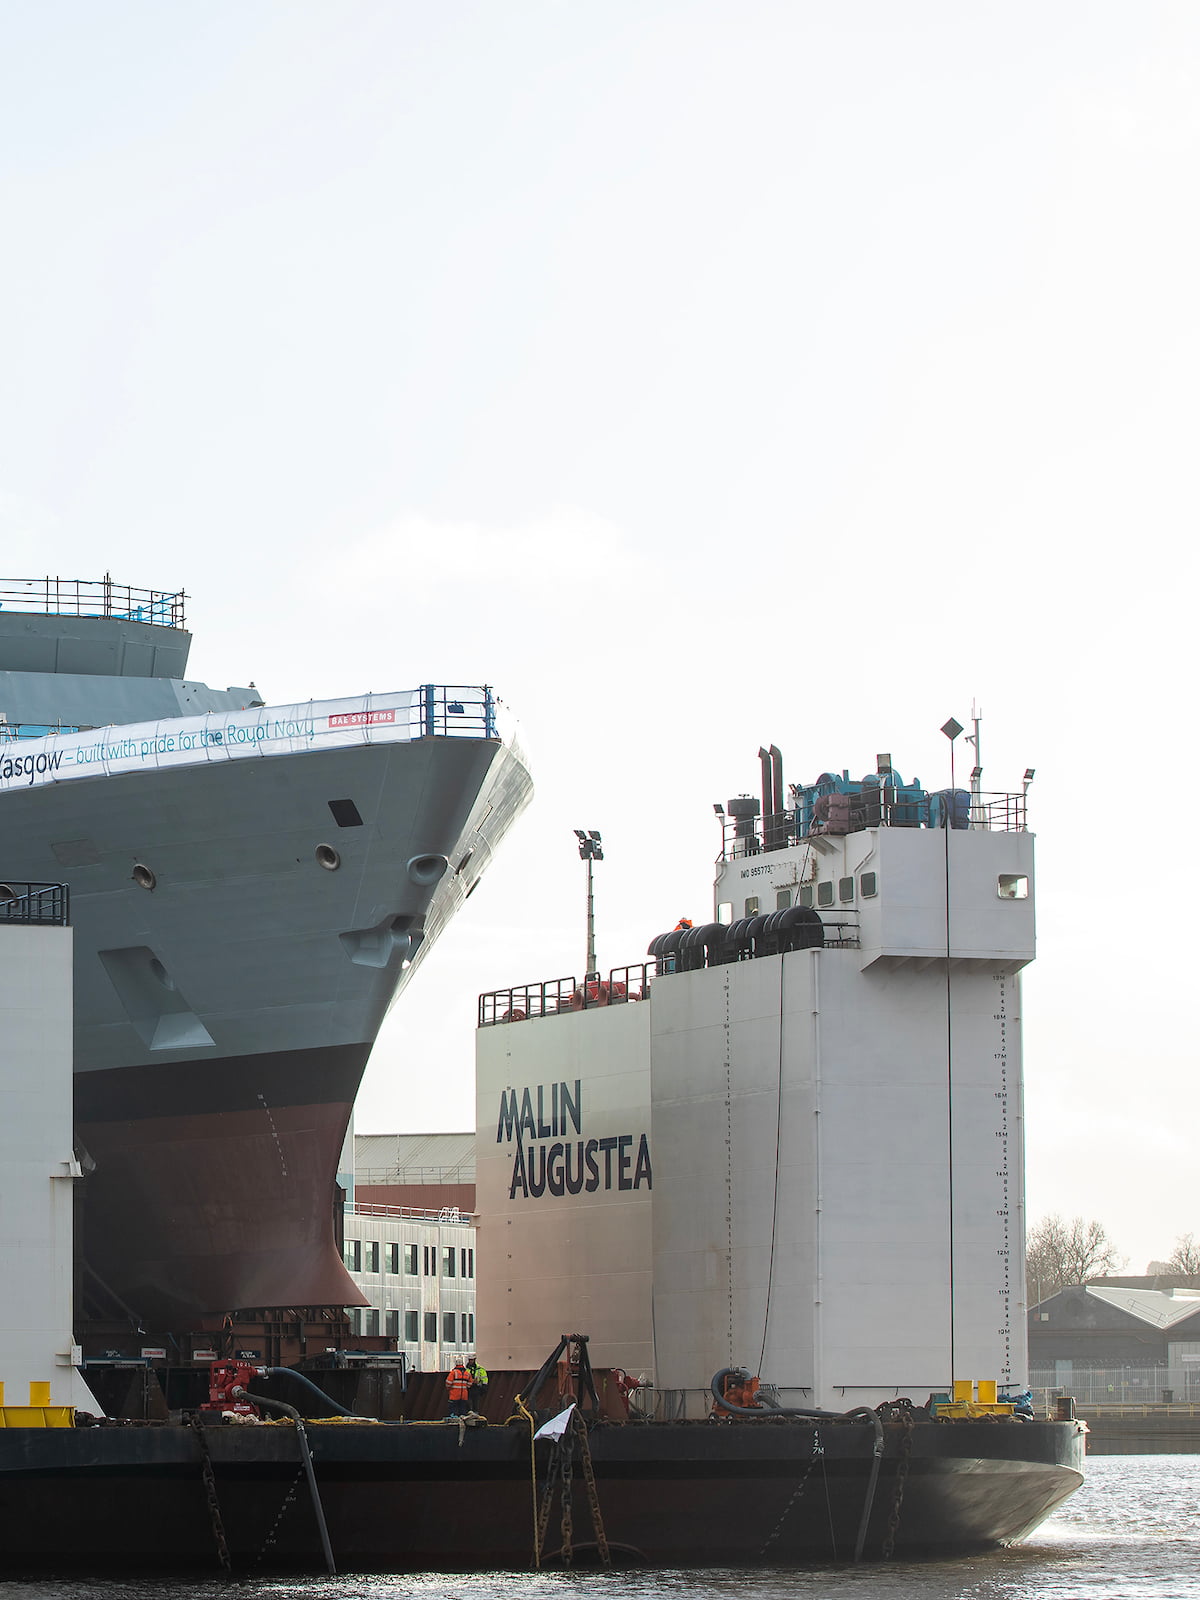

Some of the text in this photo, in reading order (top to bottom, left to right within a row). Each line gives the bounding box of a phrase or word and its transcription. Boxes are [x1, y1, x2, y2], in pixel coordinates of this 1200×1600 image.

[331, 712, 392, 725] BAE SYSTEMS
[76, 743, 105, 764] built
[108, 738, 137, 759] with
[141, 733, 175, 761] pride
[179, 730, 197, 750] for
[200, 728, 223, 747] the
[227, 719, 270, 747] Royal
[275, 718, 314, 740] Navy
[740, 869, 749, 879] IMO
[496, 1079, 581, 1143] MALIN
[509, 1133, 653, 1200] AUGUSTEA
[812, 1447, 825, 1455] 7M
